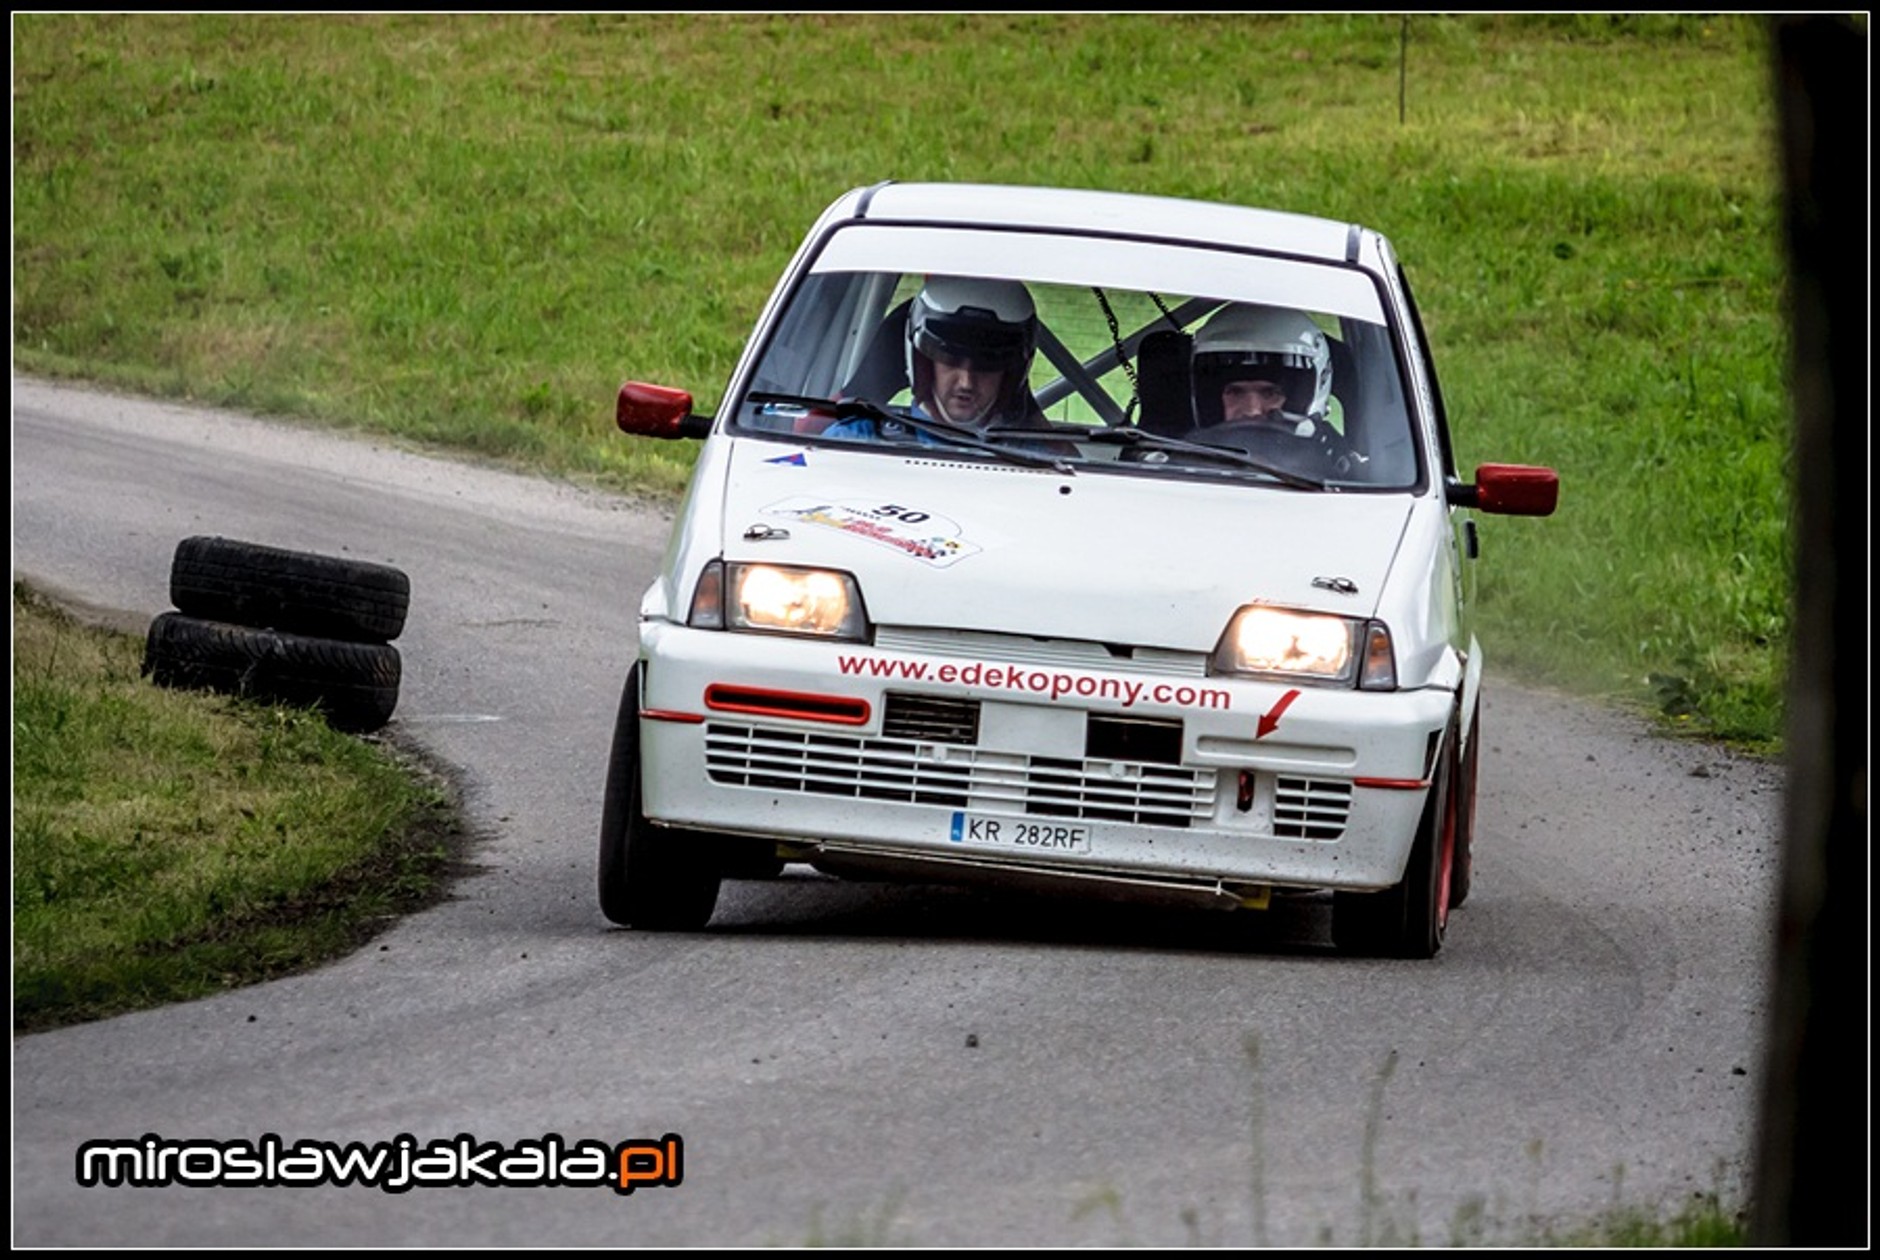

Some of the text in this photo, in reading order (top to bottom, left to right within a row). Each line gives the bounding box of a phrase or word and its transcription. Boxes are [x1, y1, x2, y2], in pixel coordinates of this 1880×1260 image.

[872, 504, 930, 524] 50
[837, 655, 1232, 710] www.edekopony.com
[968, 819, 1085, 849] KR 282RF
